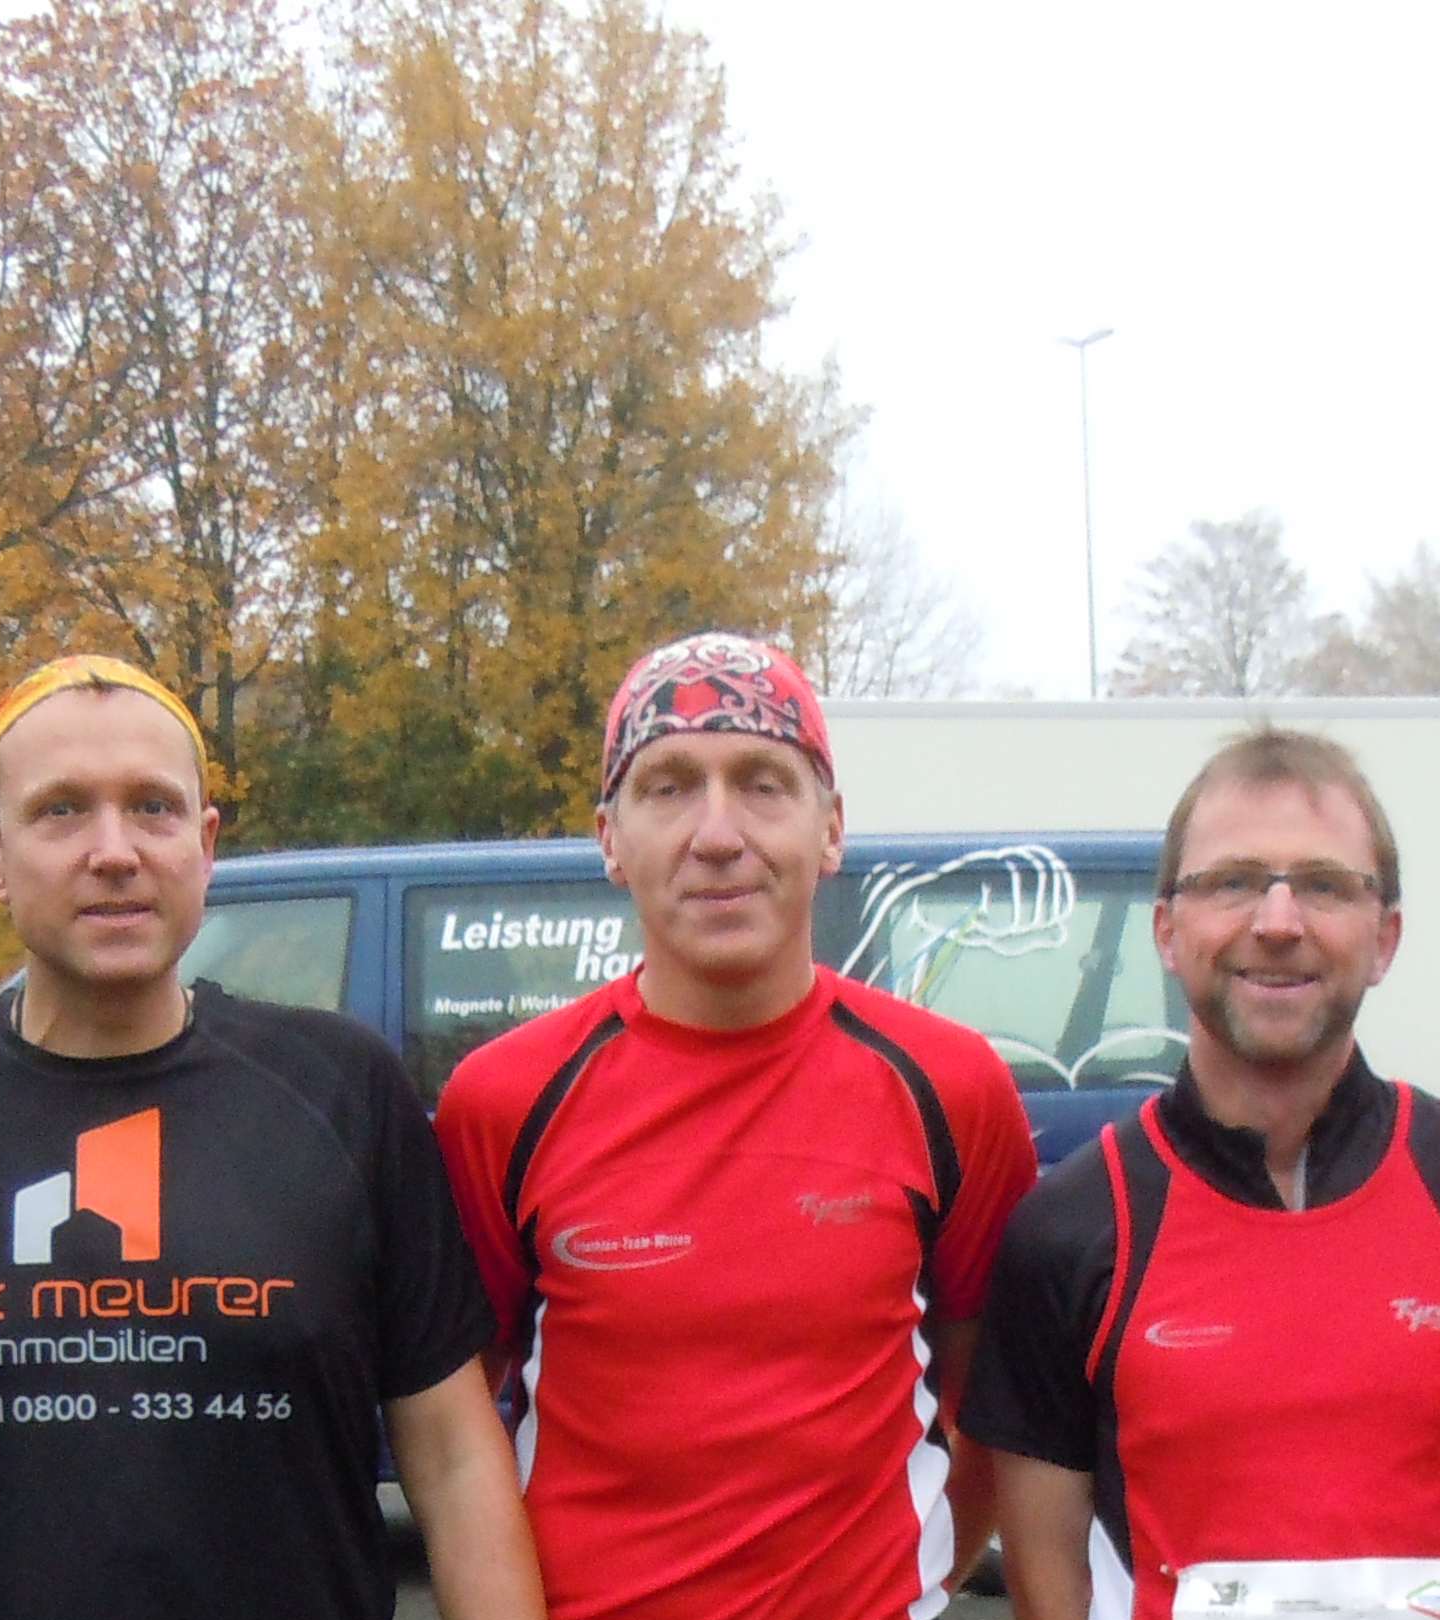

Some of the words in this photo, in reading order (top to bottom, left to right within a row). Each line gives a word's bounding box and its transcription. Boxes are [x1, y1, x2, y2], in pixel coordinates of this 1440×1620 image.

[441, 911, 623, 954] Leistung
[434, 998, 503, 1017] Magnete
[32, 1274, 294, 1319] meurer
[13, 1395, 96, 1423] 0800
[131, 1393, 193, 1420] 333
[204, 1393, 246, 1420] 44
[256, 1392, 292, 1420] 56
